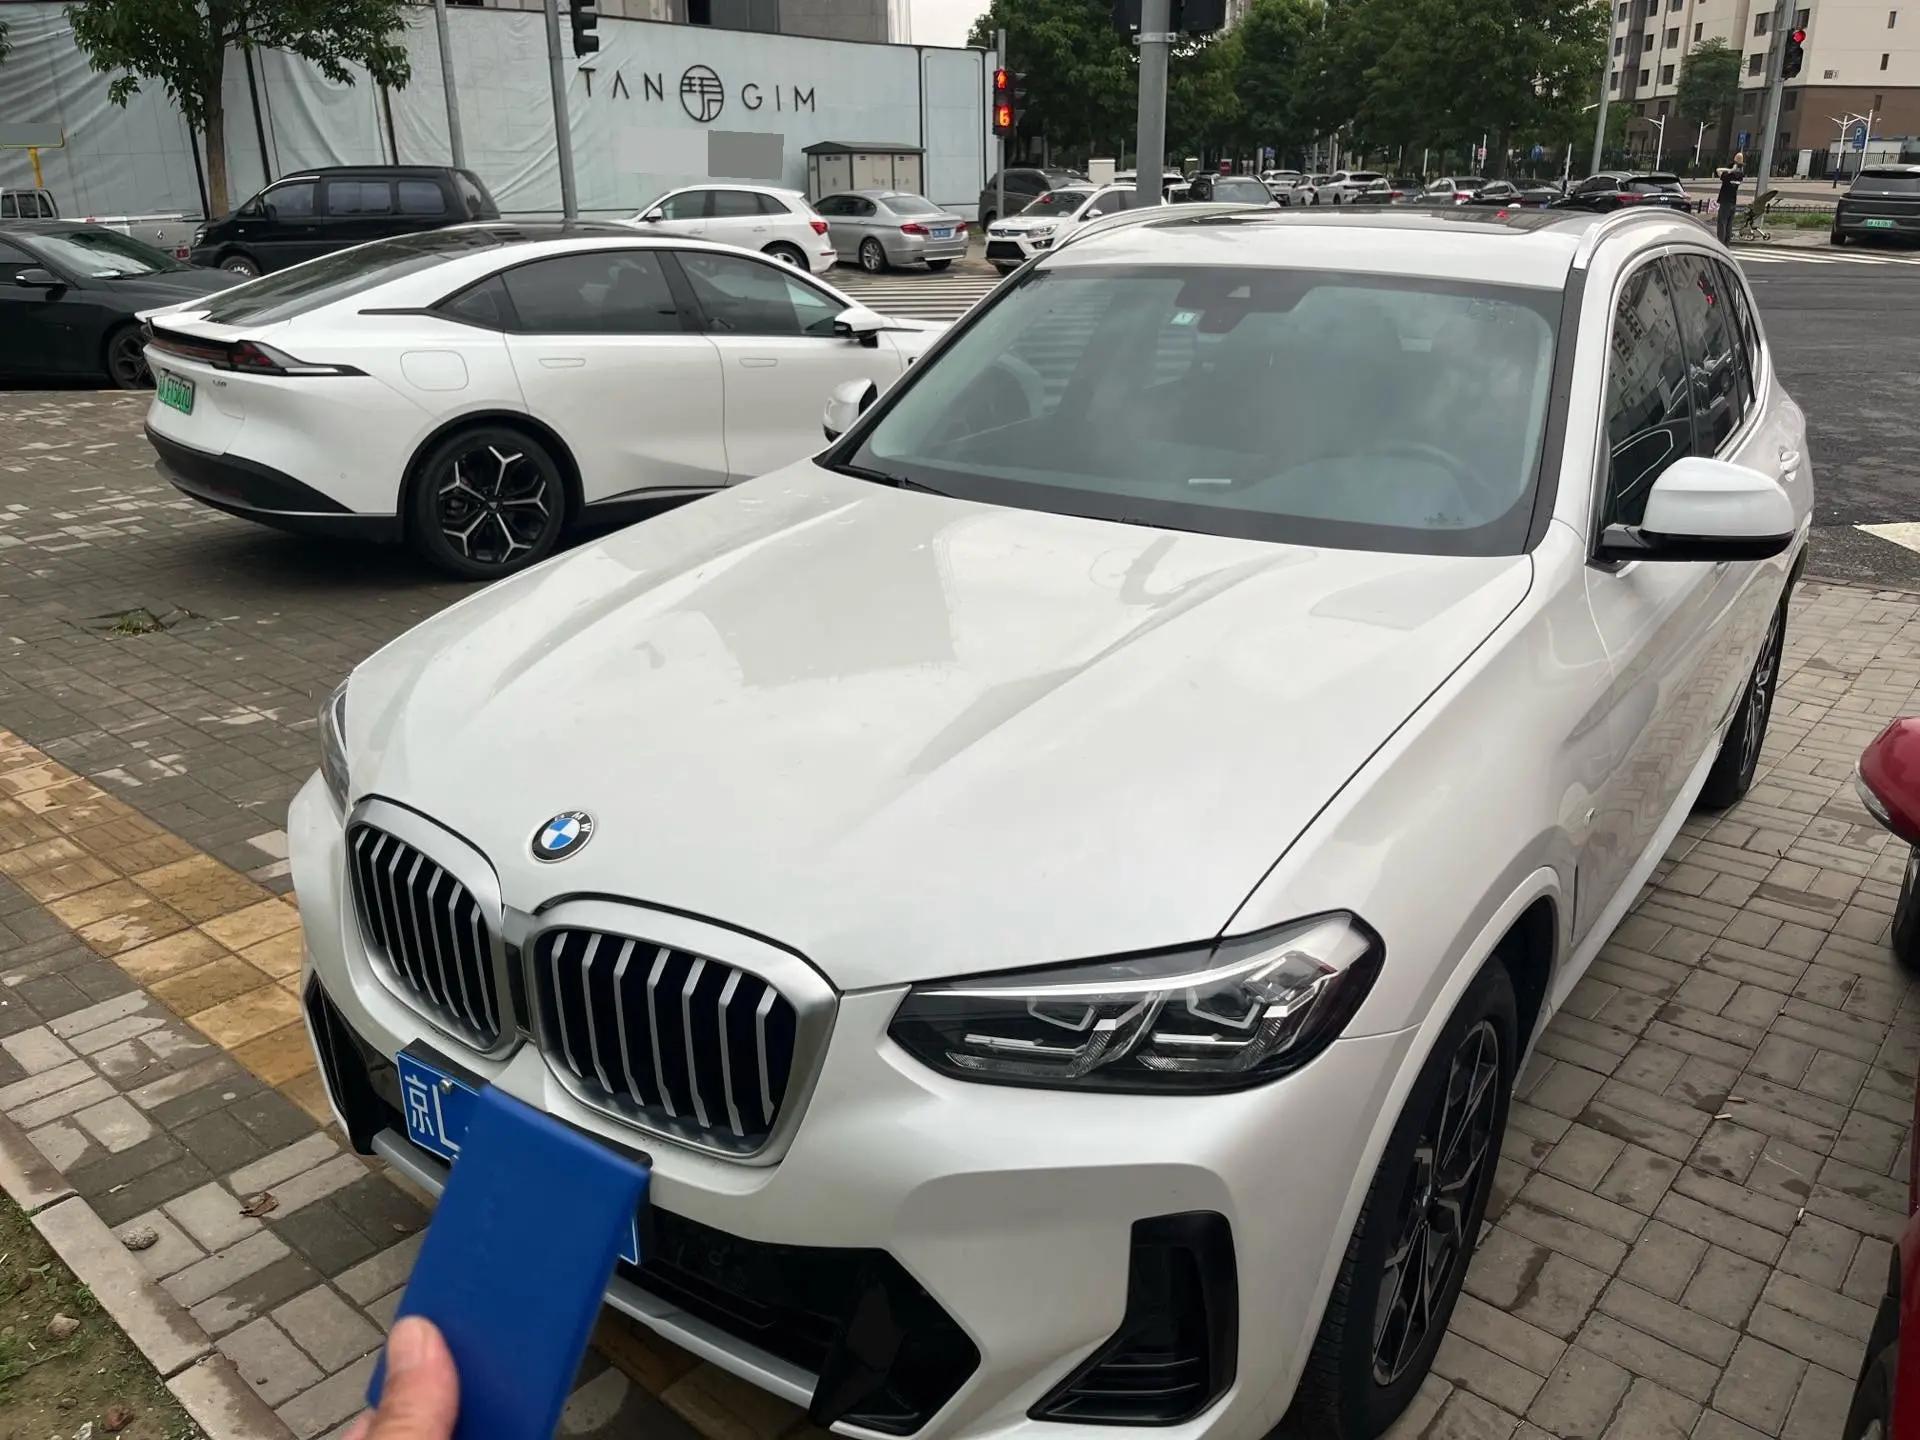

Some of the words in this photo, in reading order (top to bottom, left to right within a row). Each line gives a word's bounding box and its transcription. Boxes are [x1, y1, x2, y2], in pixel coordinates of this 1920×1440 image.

[578, 67, 664, 102] TAN
[741, 83, 816, 113] GIM
[999, 105, 1011, 127] 6
